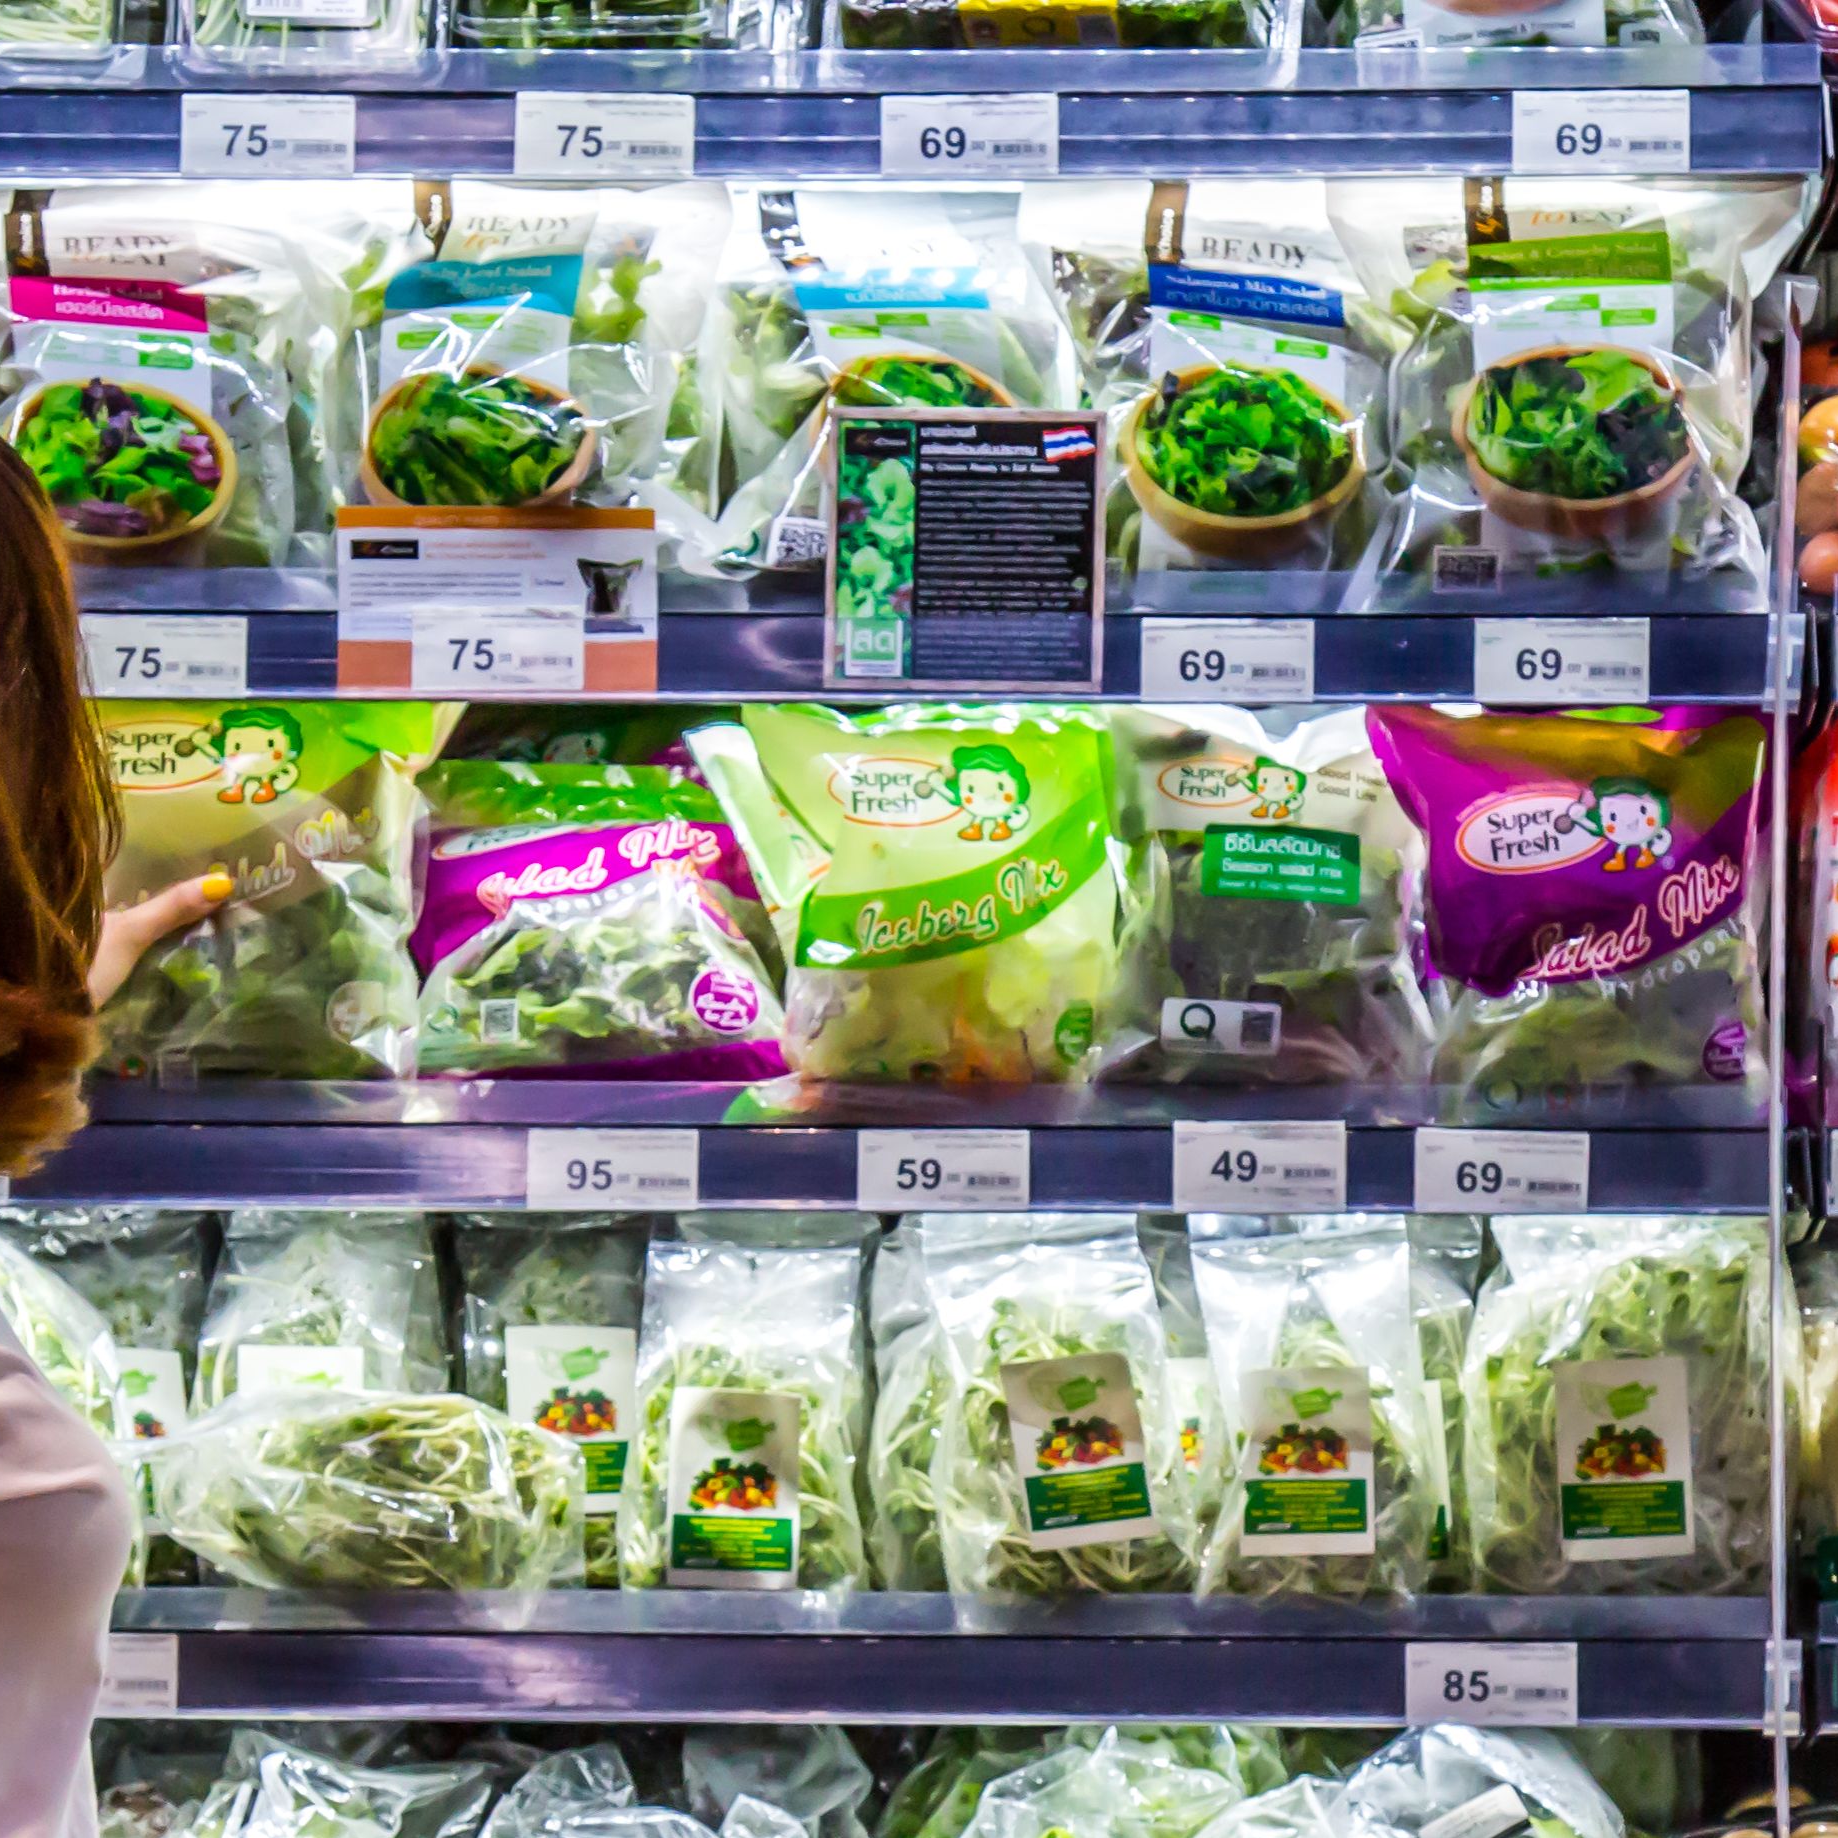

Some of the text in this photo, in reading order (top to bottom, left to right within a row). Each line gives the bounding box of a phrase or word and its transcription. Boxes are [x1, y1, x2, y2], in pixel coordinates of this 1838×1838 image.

[850, 770, 913, 793] Super
[852, 789, 918, 815] Fresh
[1486, 807, 1555, 834] Super
[1489, 830, 1560, 863] Fresh
[996, 855, 1068, 915] Mx
[1521, 902, 1652, 979] Salad
[1657, 853, 1741, 938] Mix
